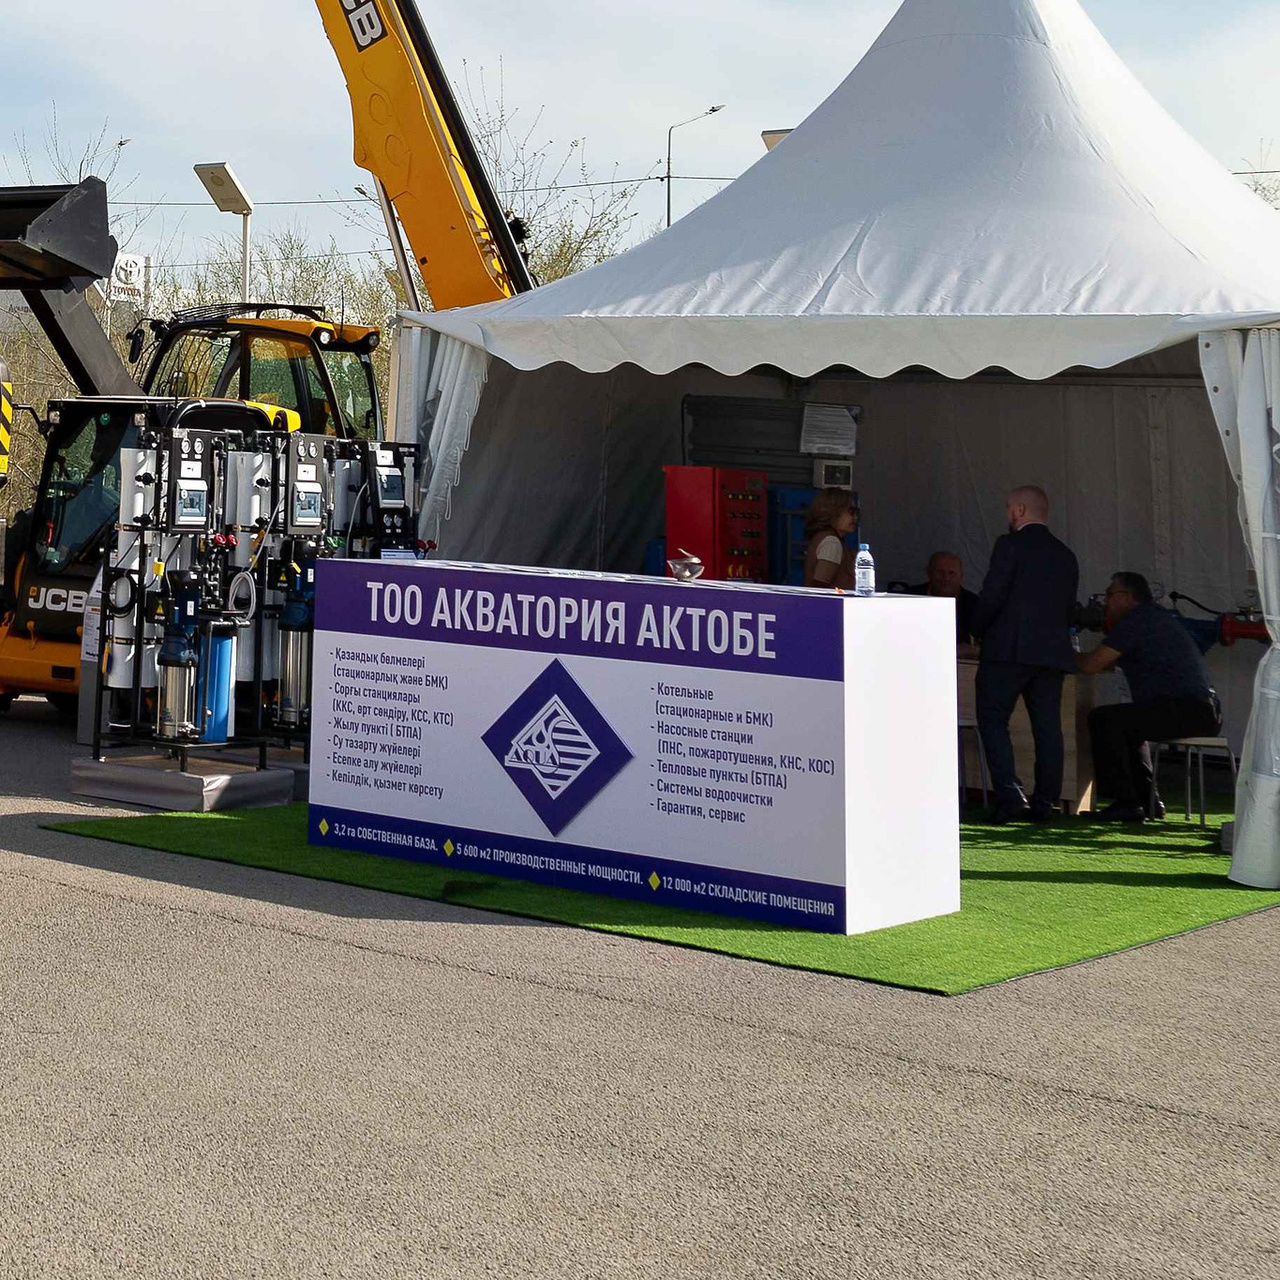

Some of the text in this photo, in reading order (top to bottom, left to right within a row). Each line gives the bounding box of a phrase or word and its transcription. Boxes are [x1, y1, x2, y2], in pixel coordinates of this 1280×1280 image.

[28, 587, 89, 613] JCB
[367, 582, 776, 659] ТОО АКВАТОРИЯ АКТОБЕ
[336, 647, 425, 668] Қазандық бөлмелері
[333, 664, 448, 690] (стационарлық және БМҚ)
[335, 682, 420, 704] Сорғы станциялары
[658, 682, 713, 700] Котельные
[333, 700, 453, 726] (ККС, өрт сөндіру, КСС, КТС)
[334, 717, 359, 732] Жылу
[361, 723, 388, 735] пункті
[656, 700, 773, 727] (стационарные и БМК)
[658, 721, 753, 744] Насосные станции
[333, 735, 420, 758] Су тазарту жүйелері
[510, 746, 559, 767] AQUA
[658, 739, 834, 775] (ПНС, пожаротушения, КНС, КОС)
[333, 752, 422, 776] Есепке алу жүйелері
[657, 759, 787, 789] Тепловые пункты (БТПА)
[333, 770, 443, 799] Кепілдік, қызмет көрсету
[657, 779, 773, 807] Системы водоочистки
[657, 798, 745, 823] Гарантия, сервис
[334, 823, 834, 915] 3,2 га СОБСТВЕННАЯ БАЗА. 5 600 м2 ПРОИЗВОДСТВЕННЫЕ МОЩНОСТИ. 12 000 м2 СКЛАДСКИЕ ПОМЕЩЕНИЯ
